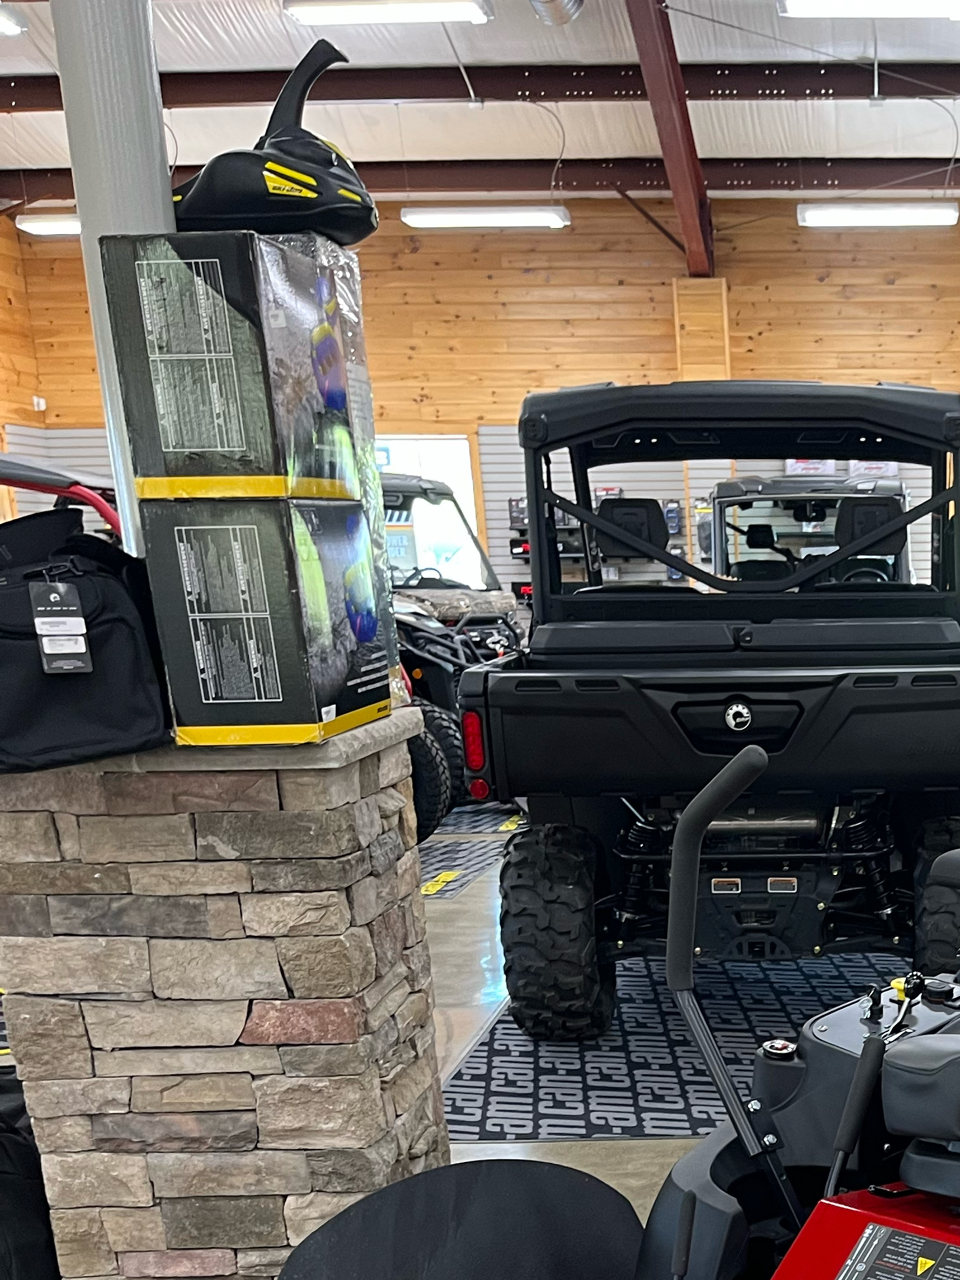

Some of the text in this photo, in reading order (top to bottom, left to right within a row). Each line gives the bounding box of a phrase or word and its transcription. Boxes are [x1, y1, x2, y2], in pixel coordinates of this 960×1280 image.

[179, 543, 192, 592] AVERTISSEMENT
[233, 541, 246, 591] AVERTISSEMENT
[626, 1035, 685, 1109] can-am
